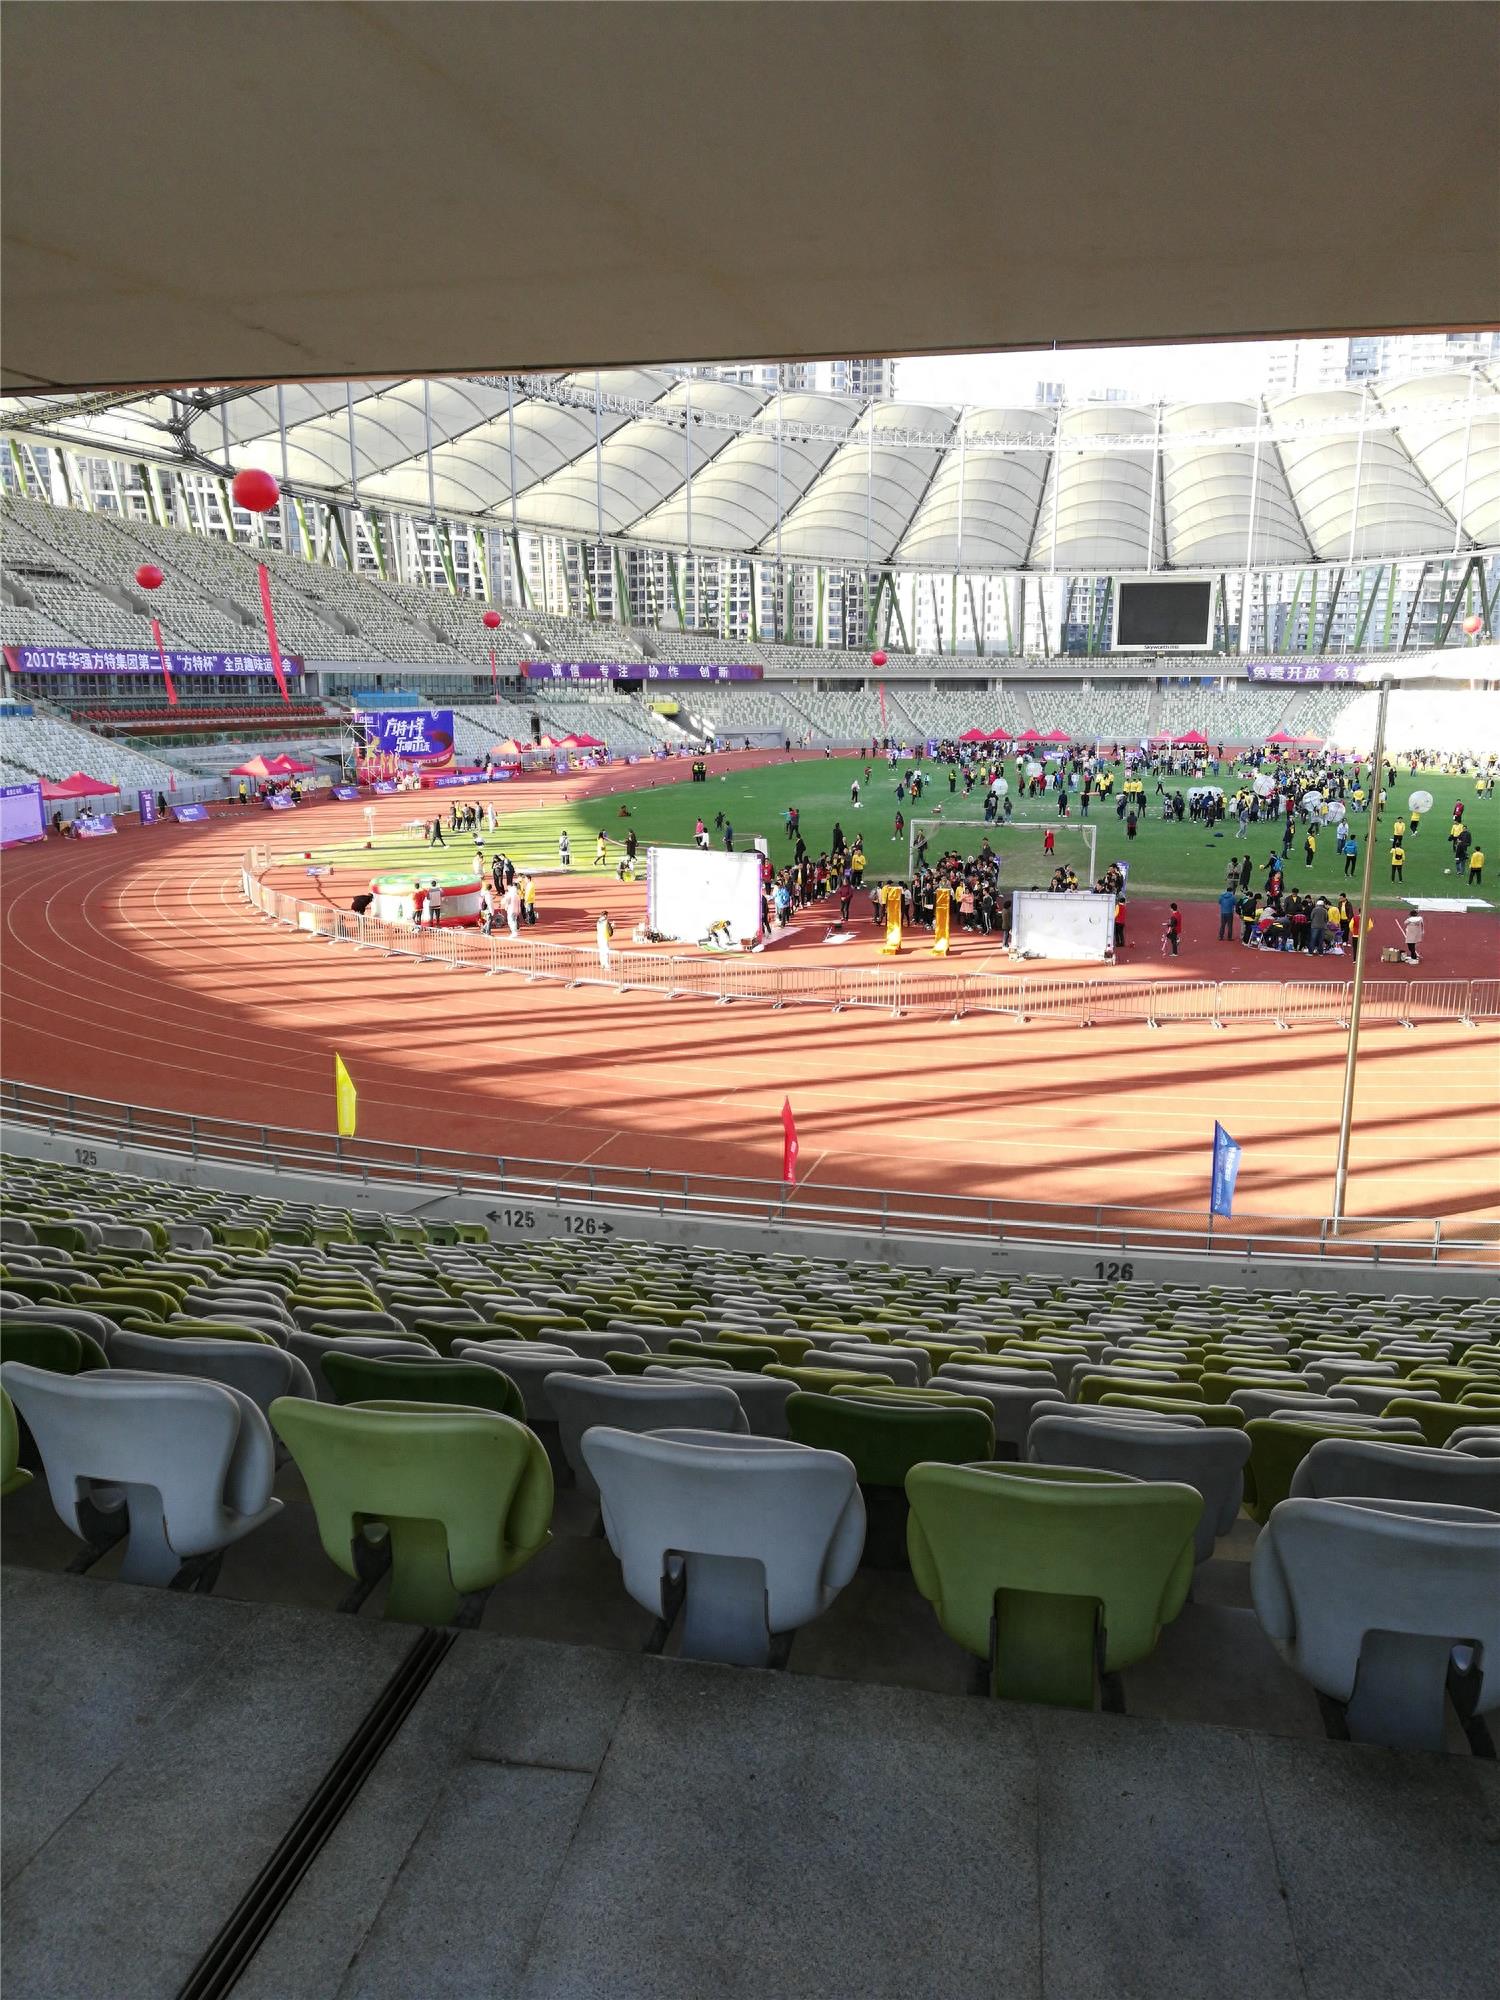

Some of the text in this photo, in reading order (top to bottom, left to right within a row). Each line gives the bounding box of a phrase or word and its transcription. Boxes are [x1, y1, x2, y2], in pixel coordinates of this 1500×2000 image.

[24, 651, 292, 673] 2017年华强方特集团第二届“方特杯”全员趣味运会
[551, 664, 729, 678] 诚信 专注 协作 创新
[1253, 666, 1322, 680] 免费开放
[75, 1148, 97, 1166] 125
[504, 1209, 596, 1235] 125 126
[1095, 1261, 1134, 1281] 126
